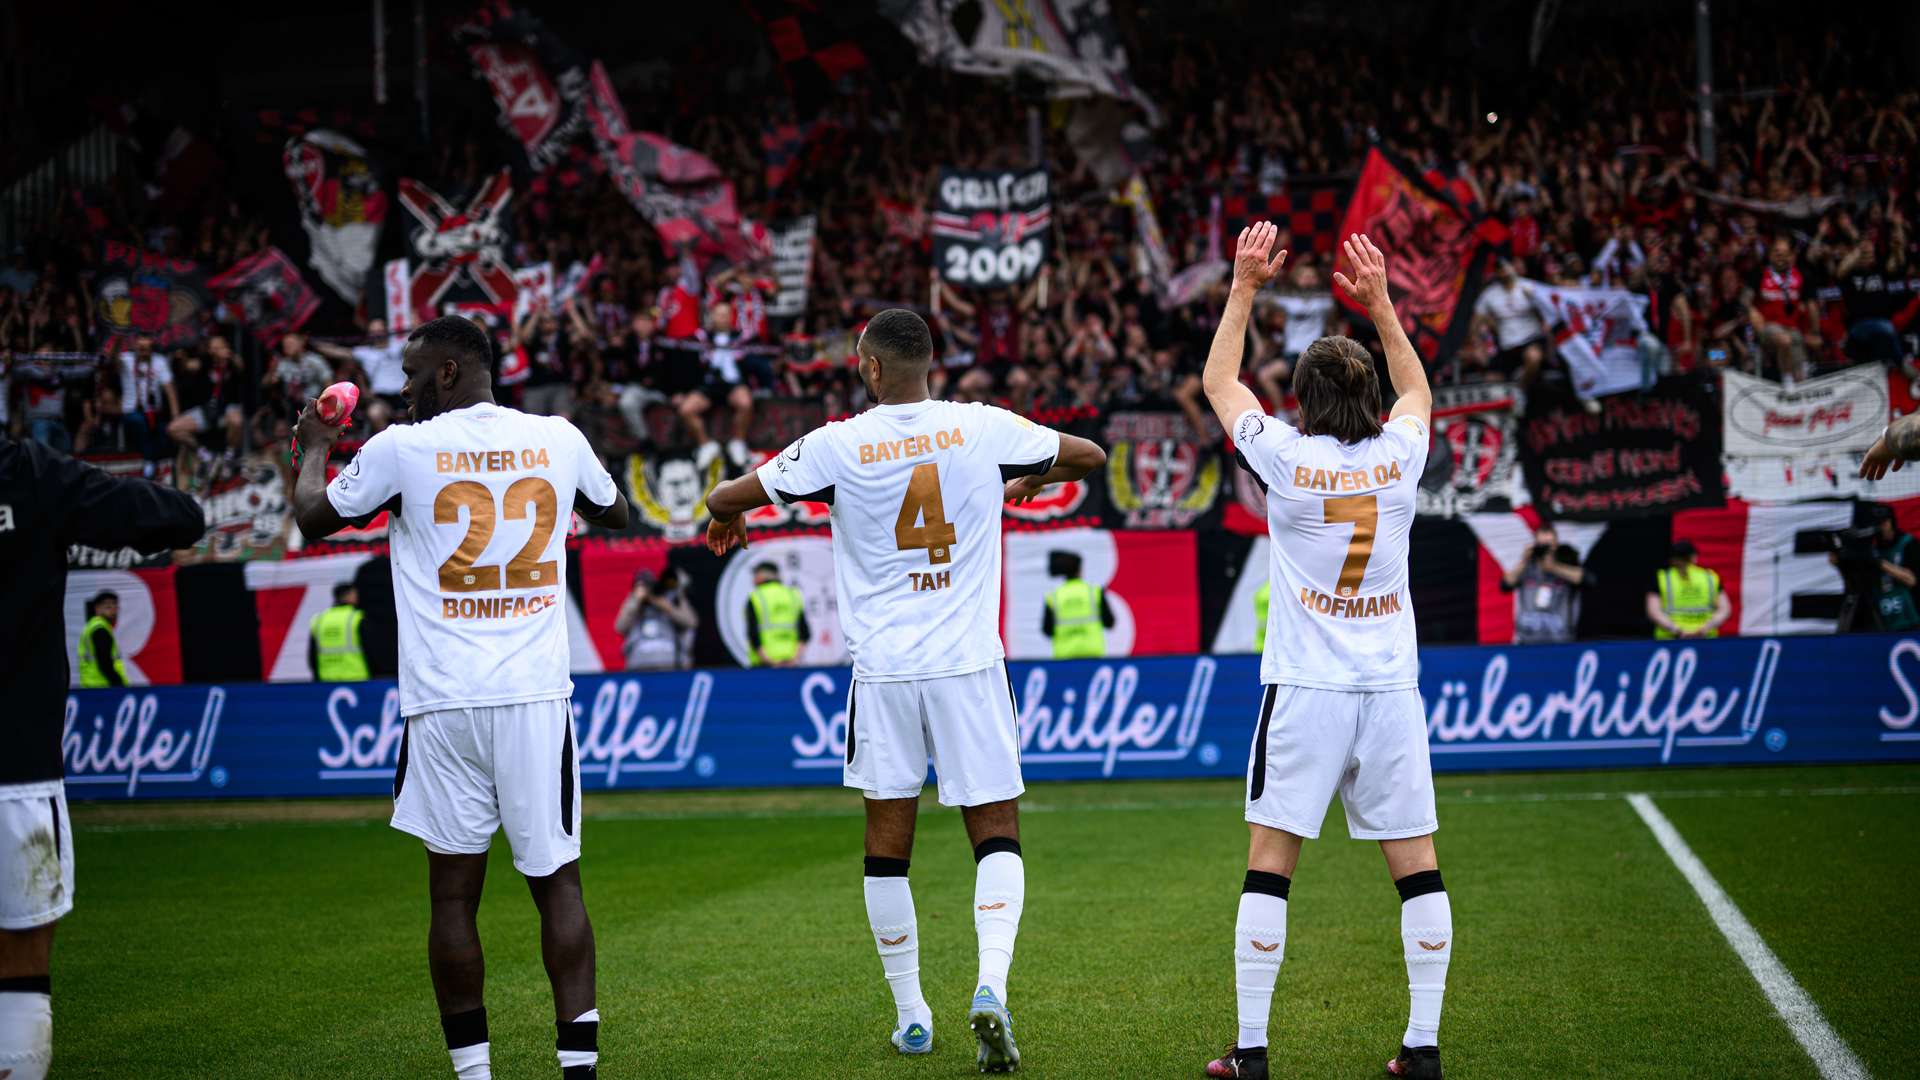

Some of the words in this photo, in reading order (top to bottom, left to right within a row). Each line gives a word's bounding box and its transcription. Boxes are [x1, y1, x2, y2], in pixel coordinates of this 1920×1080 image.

[945, 237, 1044, 284] 2009
[436, 450, 516, 473] BAYER
[520, 447, 551, 470] 04
[858, 434, 933, 465] BAYER
[935, 427, 965, 450] 04
[1293, 465, 1371, 492] BAYER
[1374, 460, 1402, 486] 04
[895, 462, 957, 565] 4
[433, 476, 559, 592] 22
[1323, 495, 1378, 598] 7
[908, 570, 951, 592] TAH
[443, 594, 556, 620] BONIFACE
[1300, 587, 1402, 619] HOFMANN
[1879, 638, 1920, 731] S
